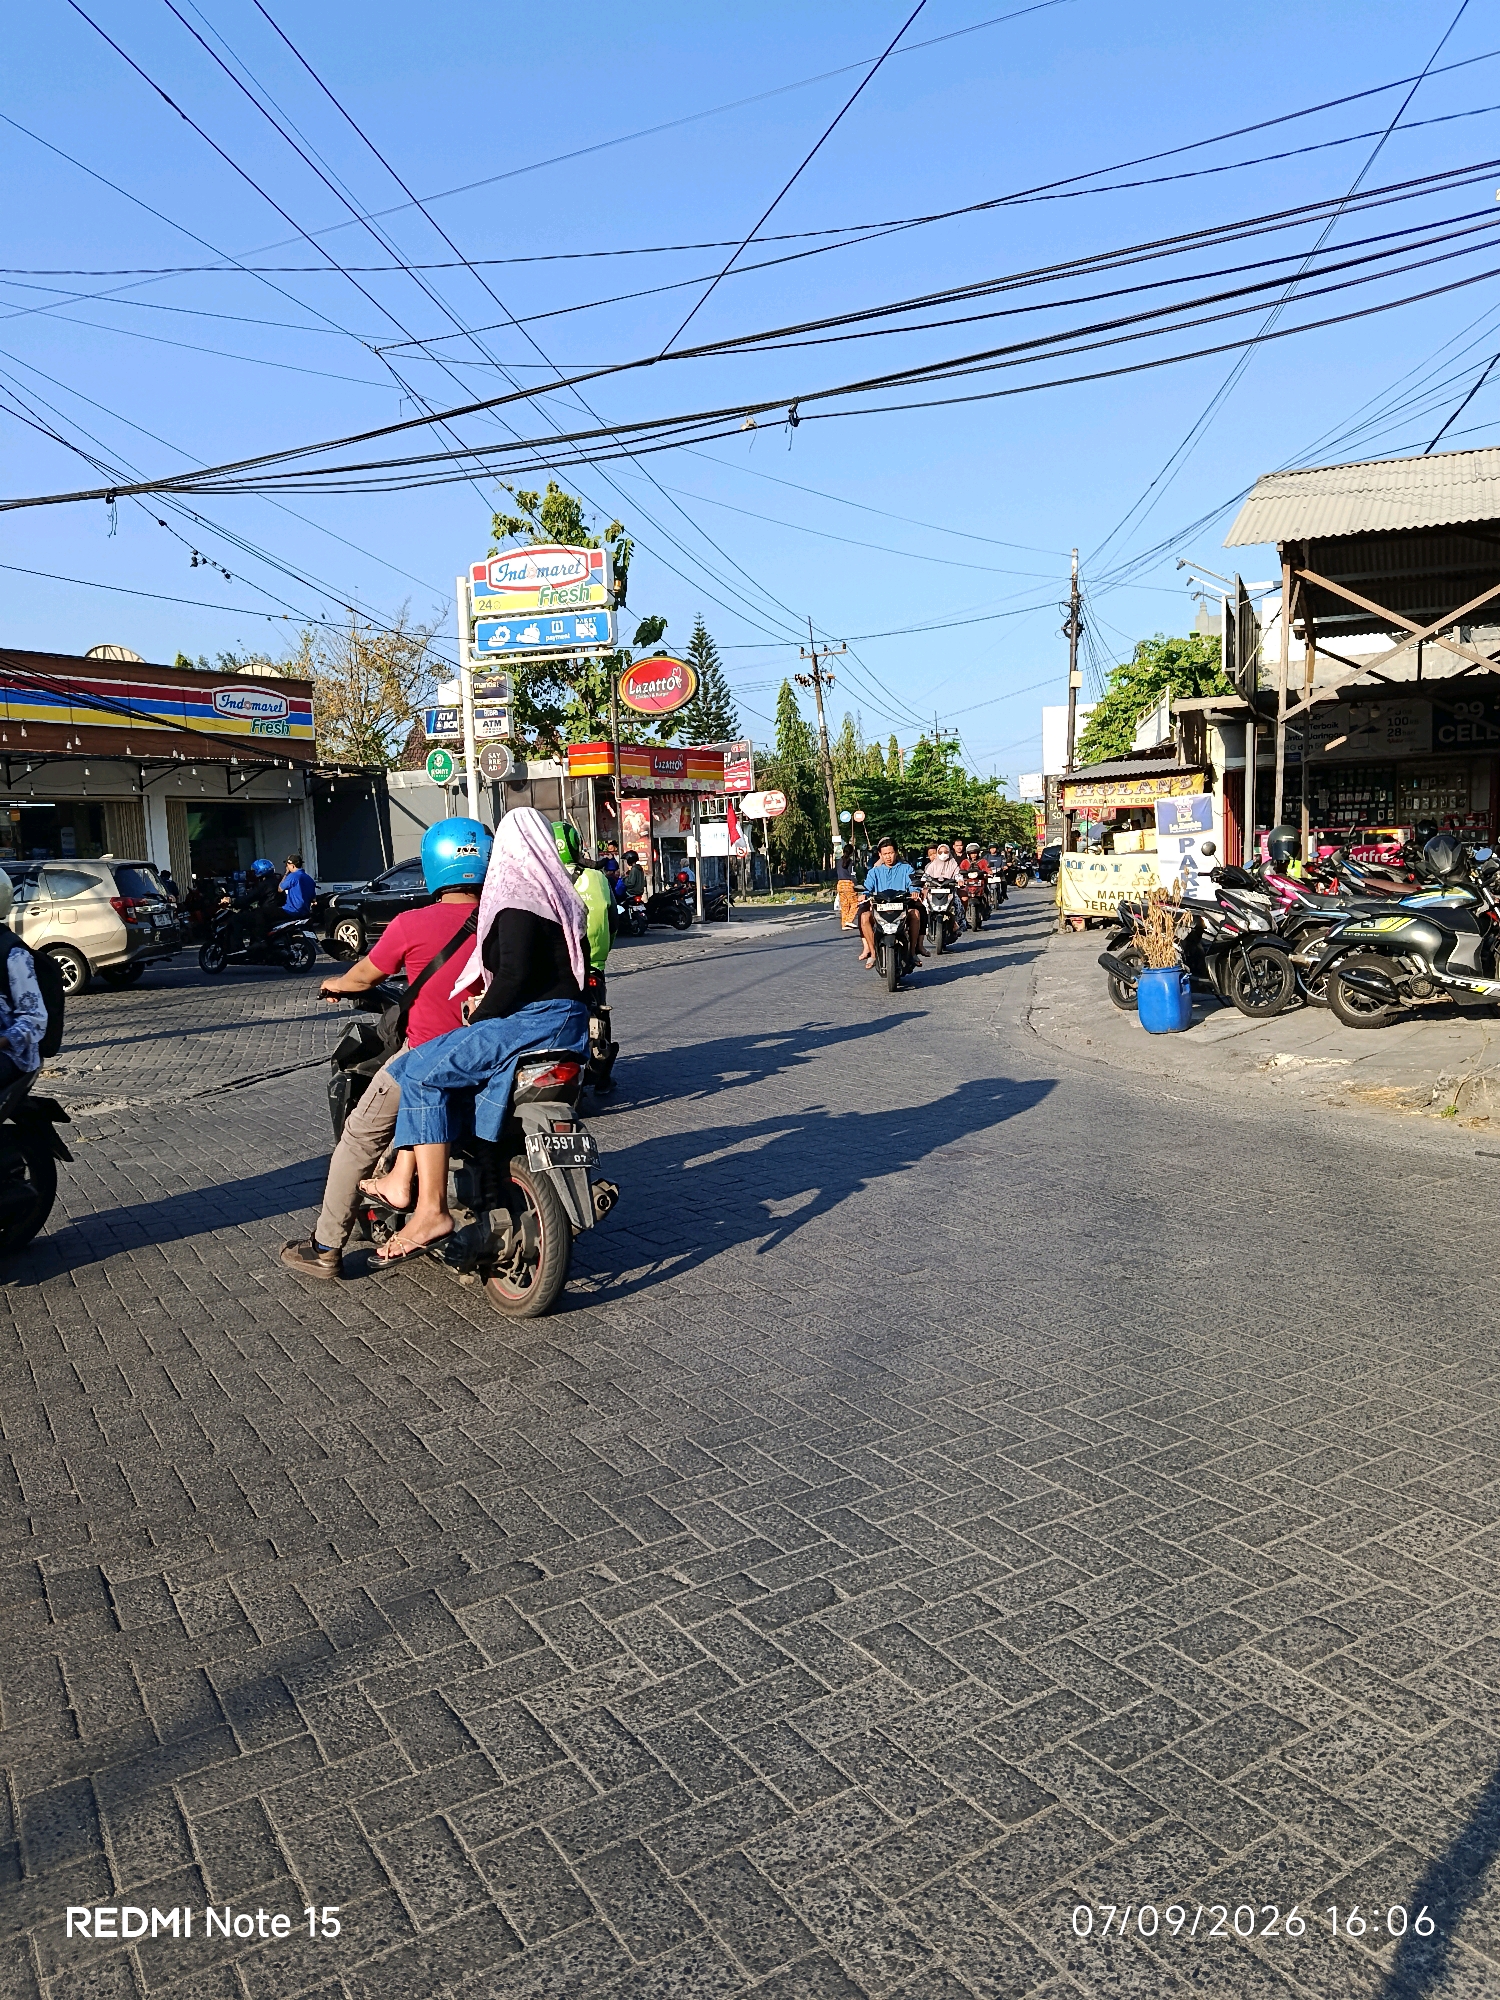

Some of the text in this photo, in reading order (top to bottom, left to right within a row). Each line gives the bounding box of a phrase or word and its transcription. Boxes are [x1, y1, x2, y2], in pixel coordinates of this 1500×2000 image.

[496, 558, 582, 583] Indomaret
[539, 582, 590, 606] Fresh
[478, 600, 493, 611] 24
[628, 676, 676, 695] Lazatto
[219, 694, 284, 713] Indomaret
[1453, 700, 1485, 720] 99
[437, 712, 454, 721] ATM
[482, 720, 502, 728] ATM
[1387, 717, 1409, 727] 100
[251, 718, 290, 735] Fresh
[1309, 721, 1339, 730] Terbaik
[1387, 728, 1402, 737] 28
[1438, 723, 1499, 743] CELL
[654, 755, 681, 770] Lazatto
[1075, 775, 1194, 797] HOLAN'S
[1070, 797, 1116, 805] MARTABAK
[1083, 899, 1117, 912] TERA
[528, 1138, 540, 1153] W
[544, 1136, 575, 1150] 2597
[573, 1155, 587, 1163] 07
